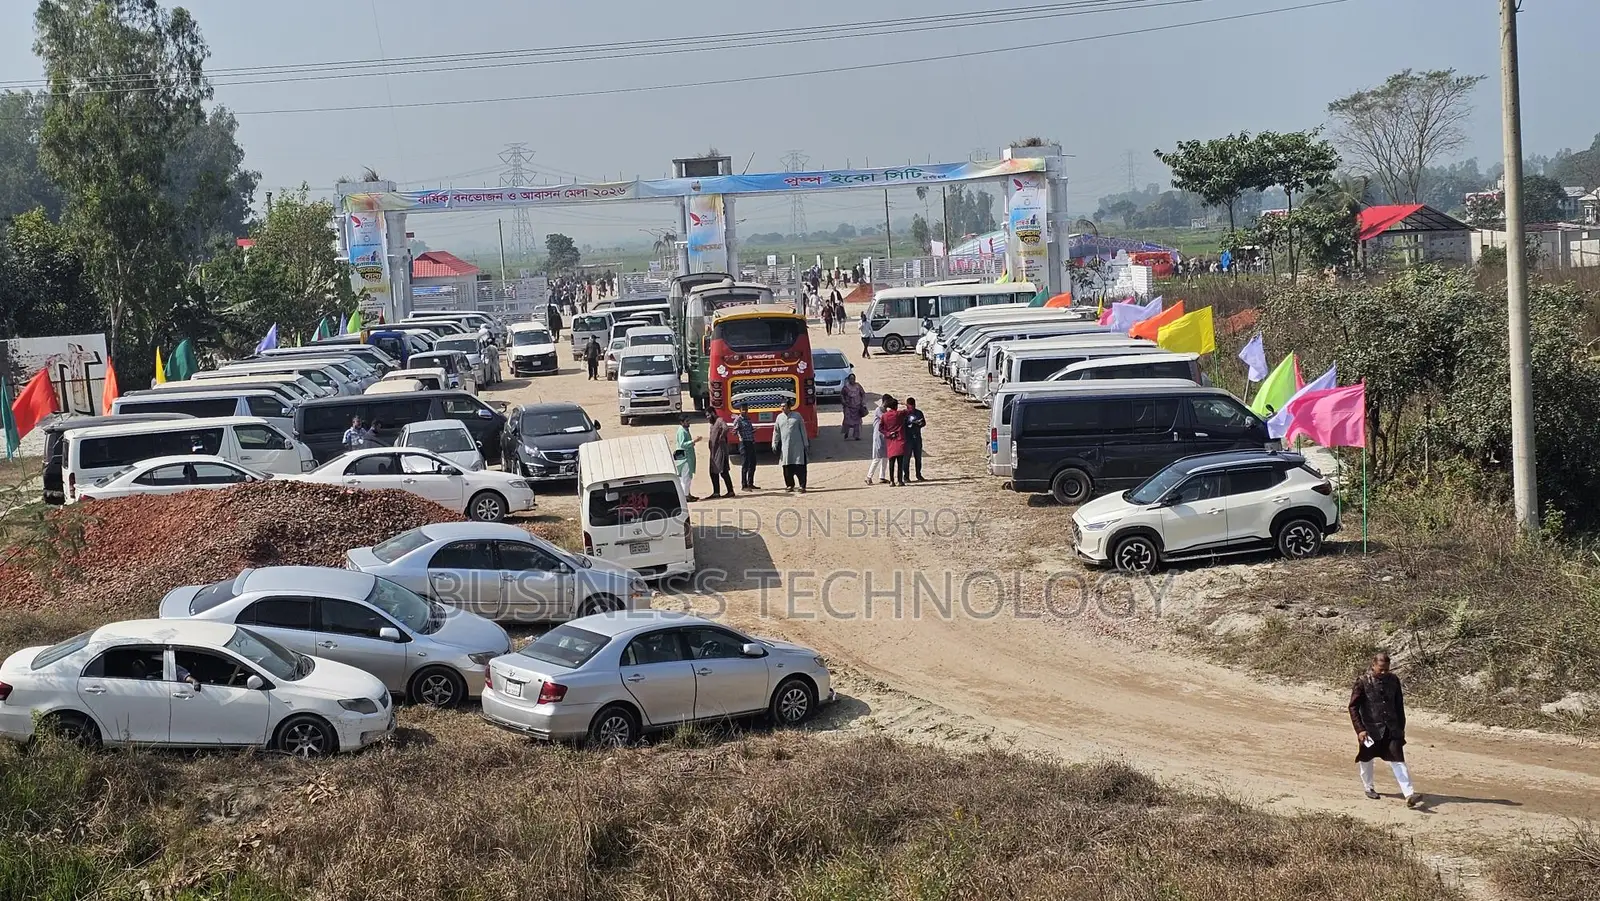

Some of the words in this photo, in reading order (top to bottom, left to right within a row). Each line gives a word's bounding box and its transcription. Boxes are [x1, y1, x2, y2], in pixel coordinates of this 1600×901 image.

[784, 174, 823, 187] পুষ্প
[829, 171, 875, 184] ইকো
[884, 167, 923, 181] সিটি
[417, 191, 449, 204] বার্ষিক
[453, 192, 503, 203] বনভোজন
[507, 192, 517, 201] ও
[519, 189, 560, 200] আবাসন
[564, 188, 588, 198] মেলা
[593, 186, 626, 197] ২০২৬
